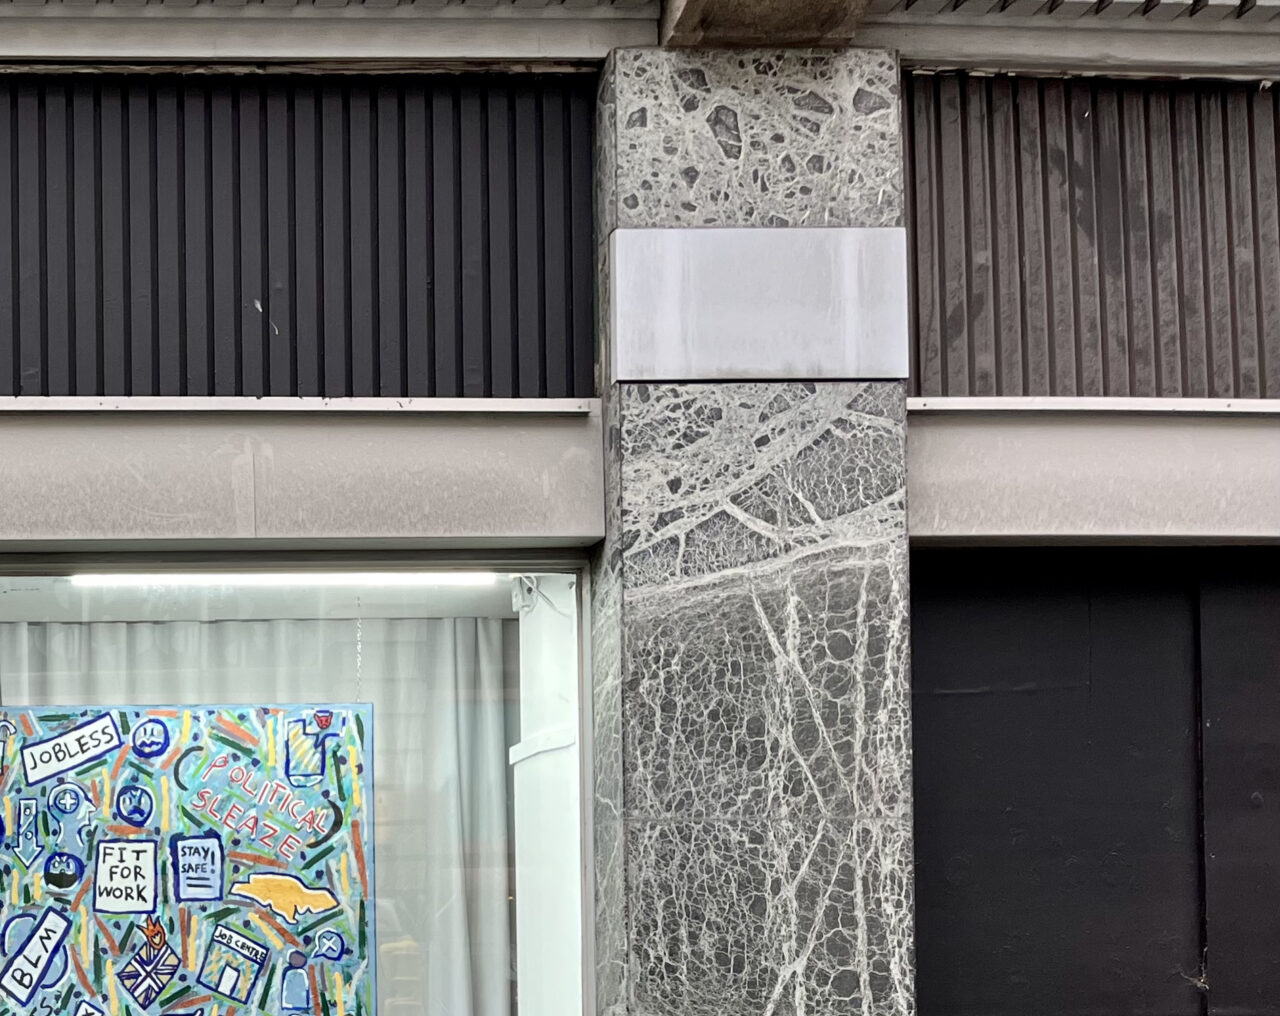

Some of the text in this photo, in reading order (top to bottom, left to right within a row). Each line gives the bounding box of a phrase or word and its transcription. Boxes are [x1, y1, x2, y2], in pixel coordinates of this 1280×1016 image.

[29, 725, 114, 770] JOBLESS
[201, 753, 328, 834] POLITICAL
[191, 788, 302, 861] SLEAZE
[102, 846, 147, 863] FIT
[180, 845, 210, 861] STAY
[109, 865, 146, 882] FOR
[98, 884, 148, 903] WORK
[10, 927, 58, 990] BLM
[214, 929, 266, 961] JOB CENTRE
